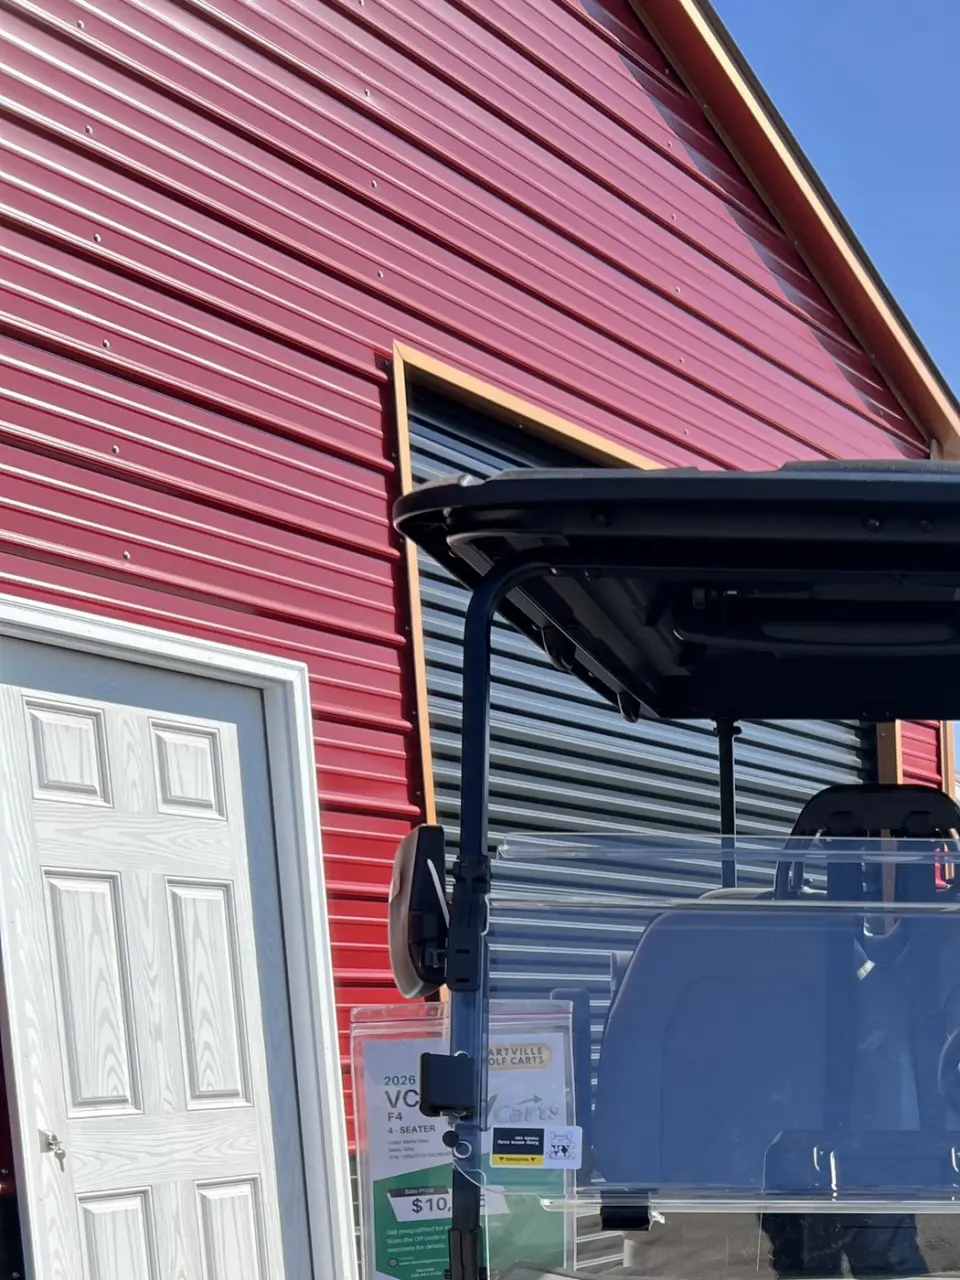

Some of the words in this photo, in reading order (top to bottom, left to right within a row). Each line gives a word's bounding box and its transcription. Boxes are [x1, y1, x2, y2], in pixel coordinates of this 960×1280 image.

[489, 1047, 543, 1056] ARTVILLE
[488, 1057, 507, 1066] OLF
[510, 1056, 544, 1065] CARTS
[384, 1075, 416, 1086] 2026
[387, 1112, 403, 1122] F4
[399, 1125, 436, 1134] SEATER
